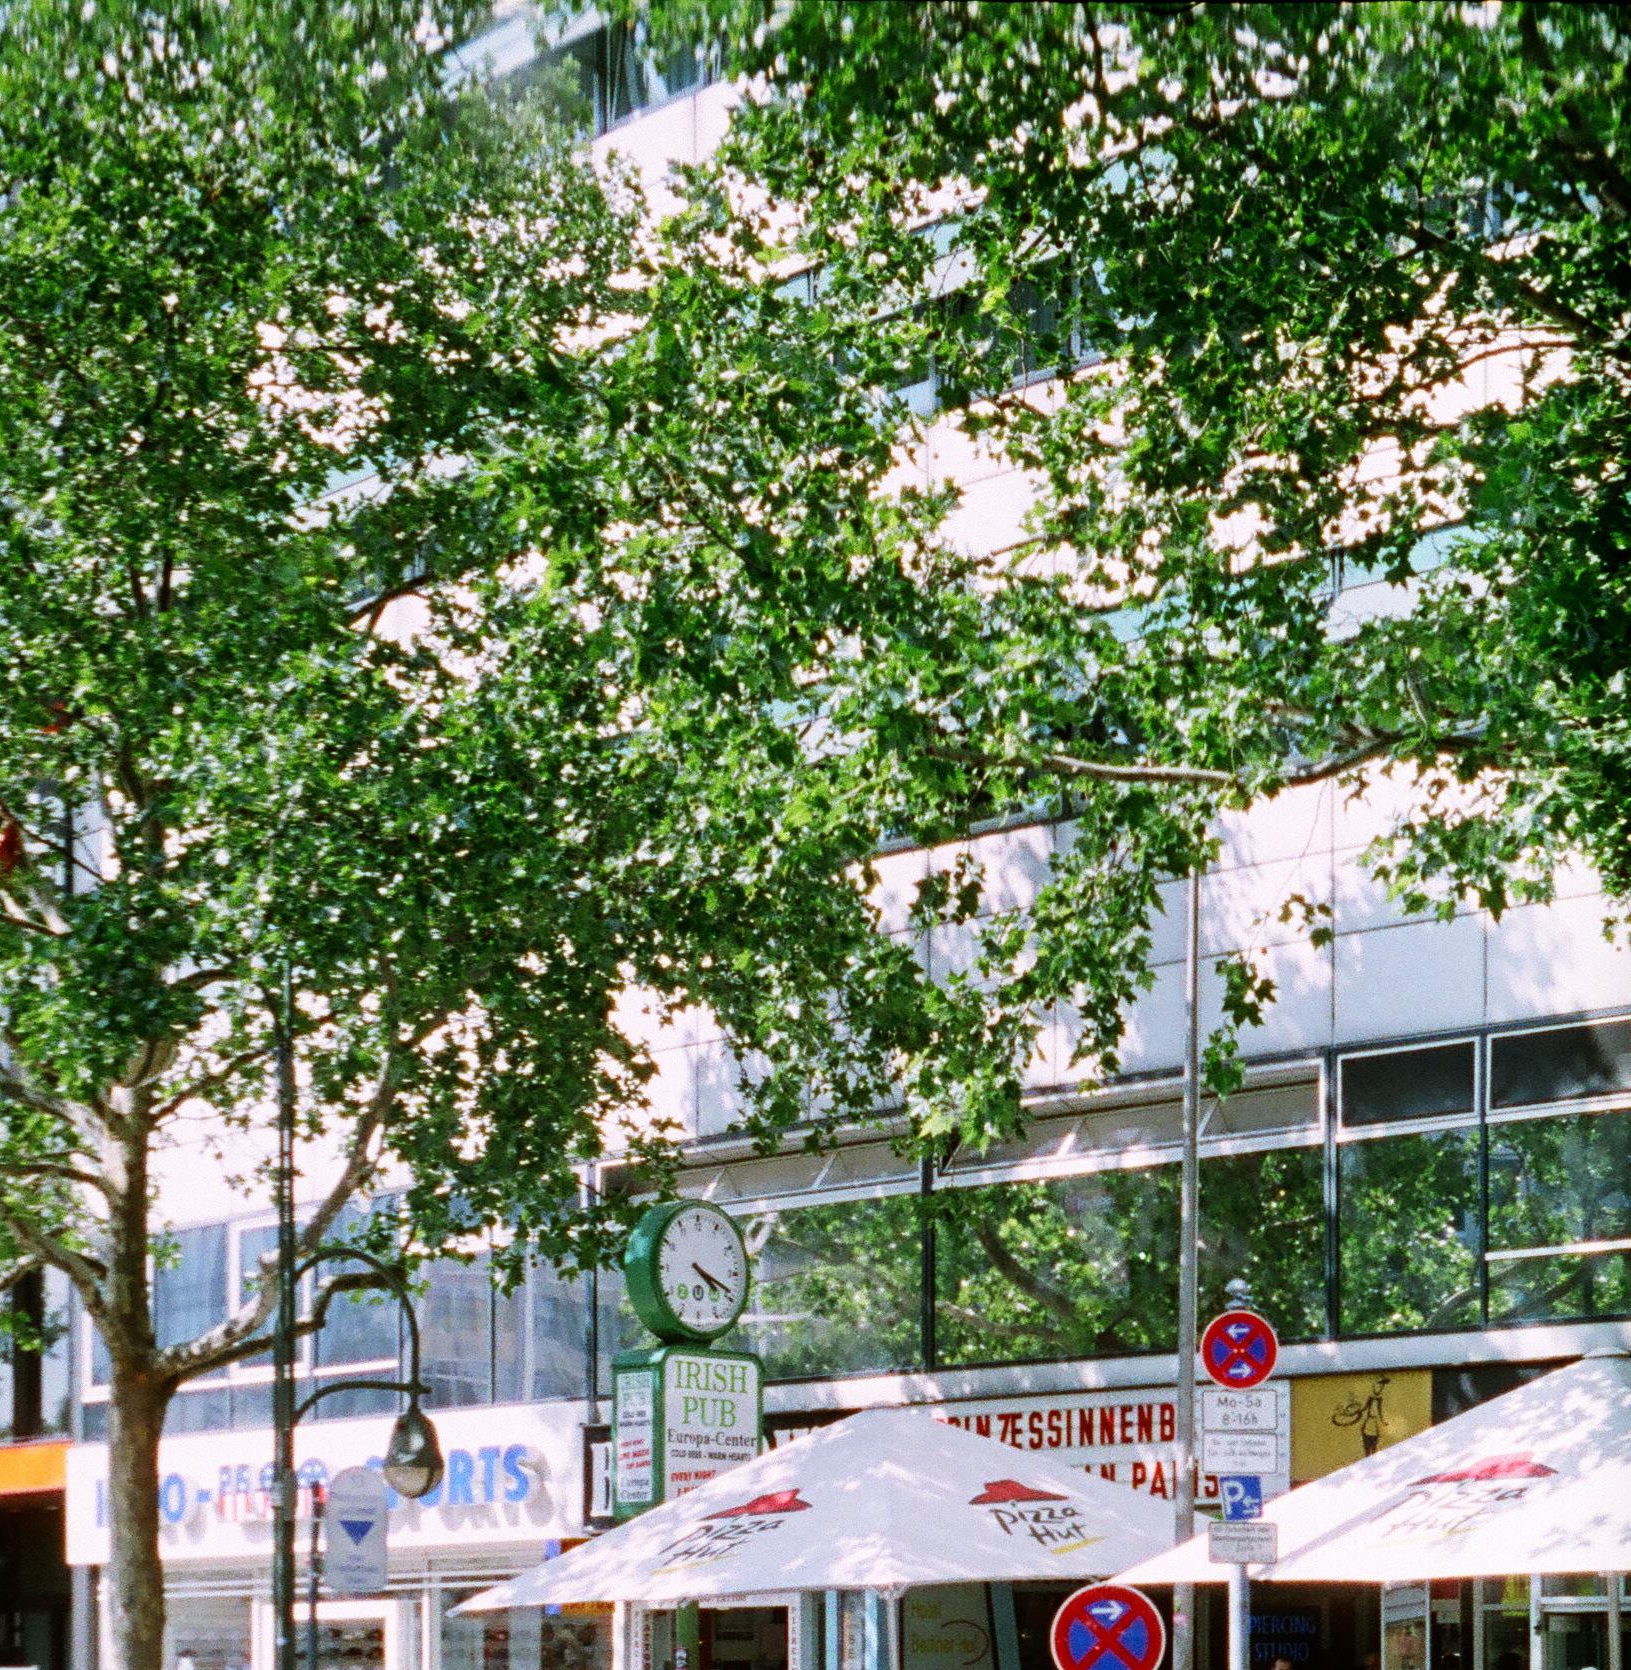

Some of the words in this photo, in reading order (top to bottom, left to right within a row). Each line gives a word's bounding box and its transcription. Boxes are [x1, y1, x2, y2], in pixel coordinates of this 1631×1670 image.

[675, 1361, 748, 1393] IRISH
[683, 1396, 738, 1427] PUB
[667, 1428, 757, 1448] Europa-Center
[1132, 1460, 1219, 1499] PAIS
[1224, 1479, 1245, 1516] P
[989, 1502, 1081, 1536] Pizza
[658, 1515, 785, 1555] Pizza
[1028, 1524, 1086, 1546] Hut
[662, 1539, 751, 1567] Hut
[1246, 1615, 1316, 1634] PIERCING
